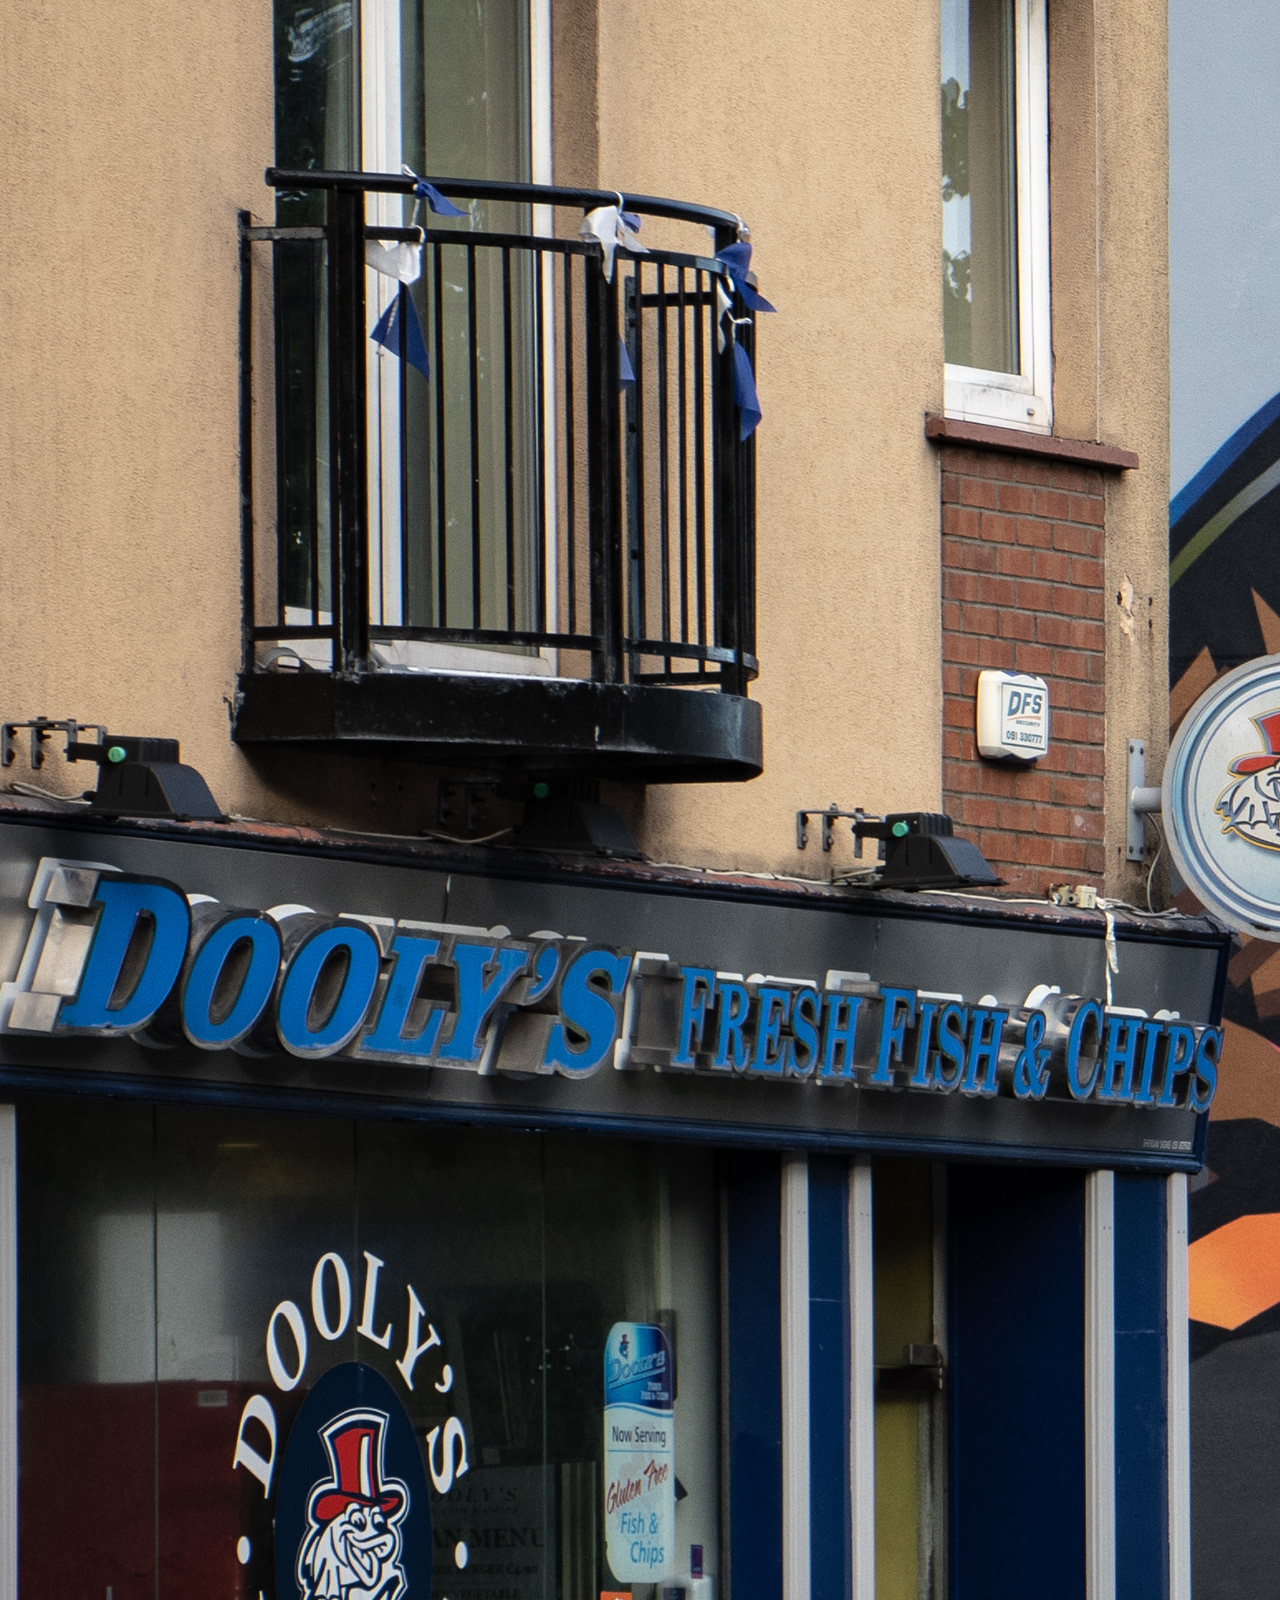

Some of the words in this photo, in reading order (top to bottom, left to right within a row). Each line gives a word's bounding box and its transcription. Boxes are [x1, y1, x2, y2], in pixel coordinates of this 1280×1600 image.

[1007, 691, 1042, 716] DFS
[1006, 731, 1018, 741] 051
[58, 873, 633, 1079] DOOLY'S
[672, 966, 862, 1081] FRESH
[869, 987, 1006, 1096] FISH
[1013, 1006, 1050, 1100] &
[1065, 998, 1224, 1113] CHIPS
[232, 1250, 469, 1499] DOOLY'S
[612, 1426, 632, 1443] Now
[634, 1426, 666, 1448] Serving
[431, 1486, 518, 1503] OOLY'S
[607, 1478, 642, 1514] Gluten
[643, 1459, 668, 1490] Free
[620, 1512, 645, 1534] Fish
[649, 1512, 657, 1534] &
[630, 1541, 665, 1568] Chips
